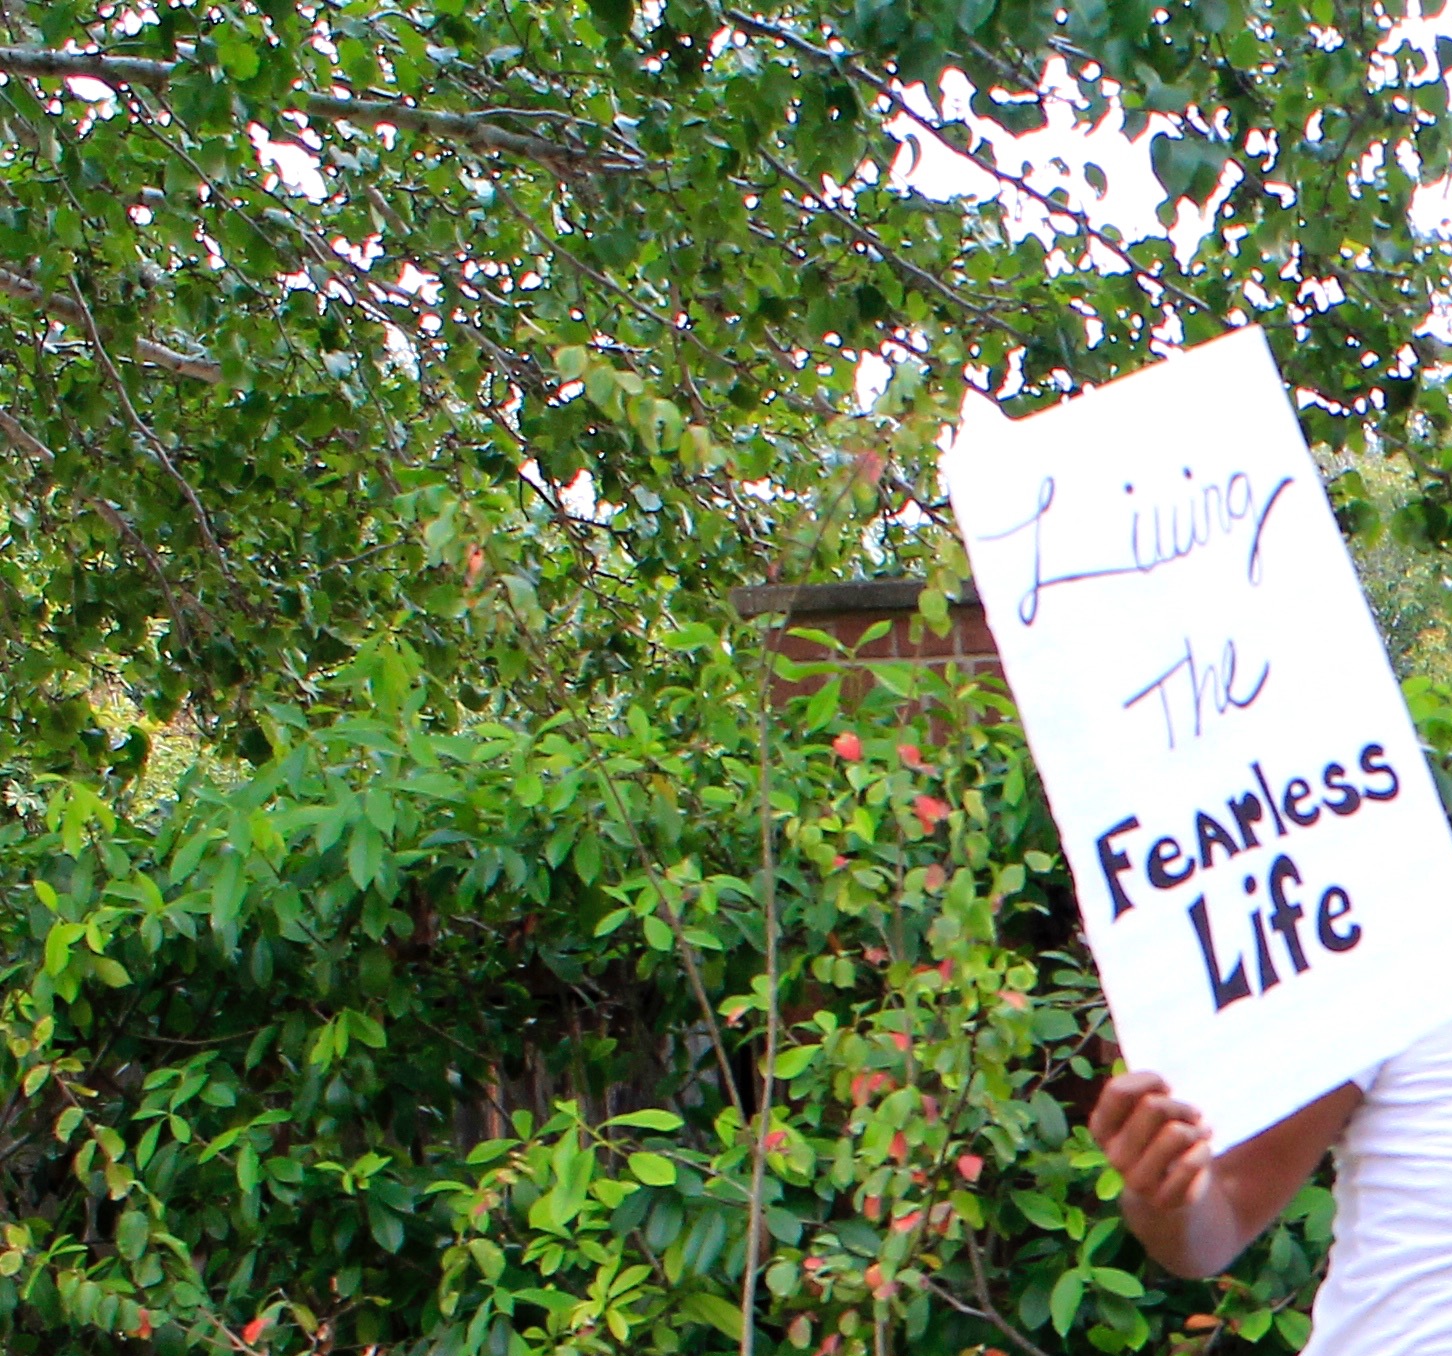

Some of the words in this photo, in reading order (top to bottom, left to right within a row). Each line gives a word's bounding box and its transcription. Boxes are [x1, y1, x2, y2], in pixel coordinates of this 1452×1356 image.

[978, 467, 1293, 624] Living
[1123, 635, 1270, 749] The
[1188, 852, 1362, 1013] Life
